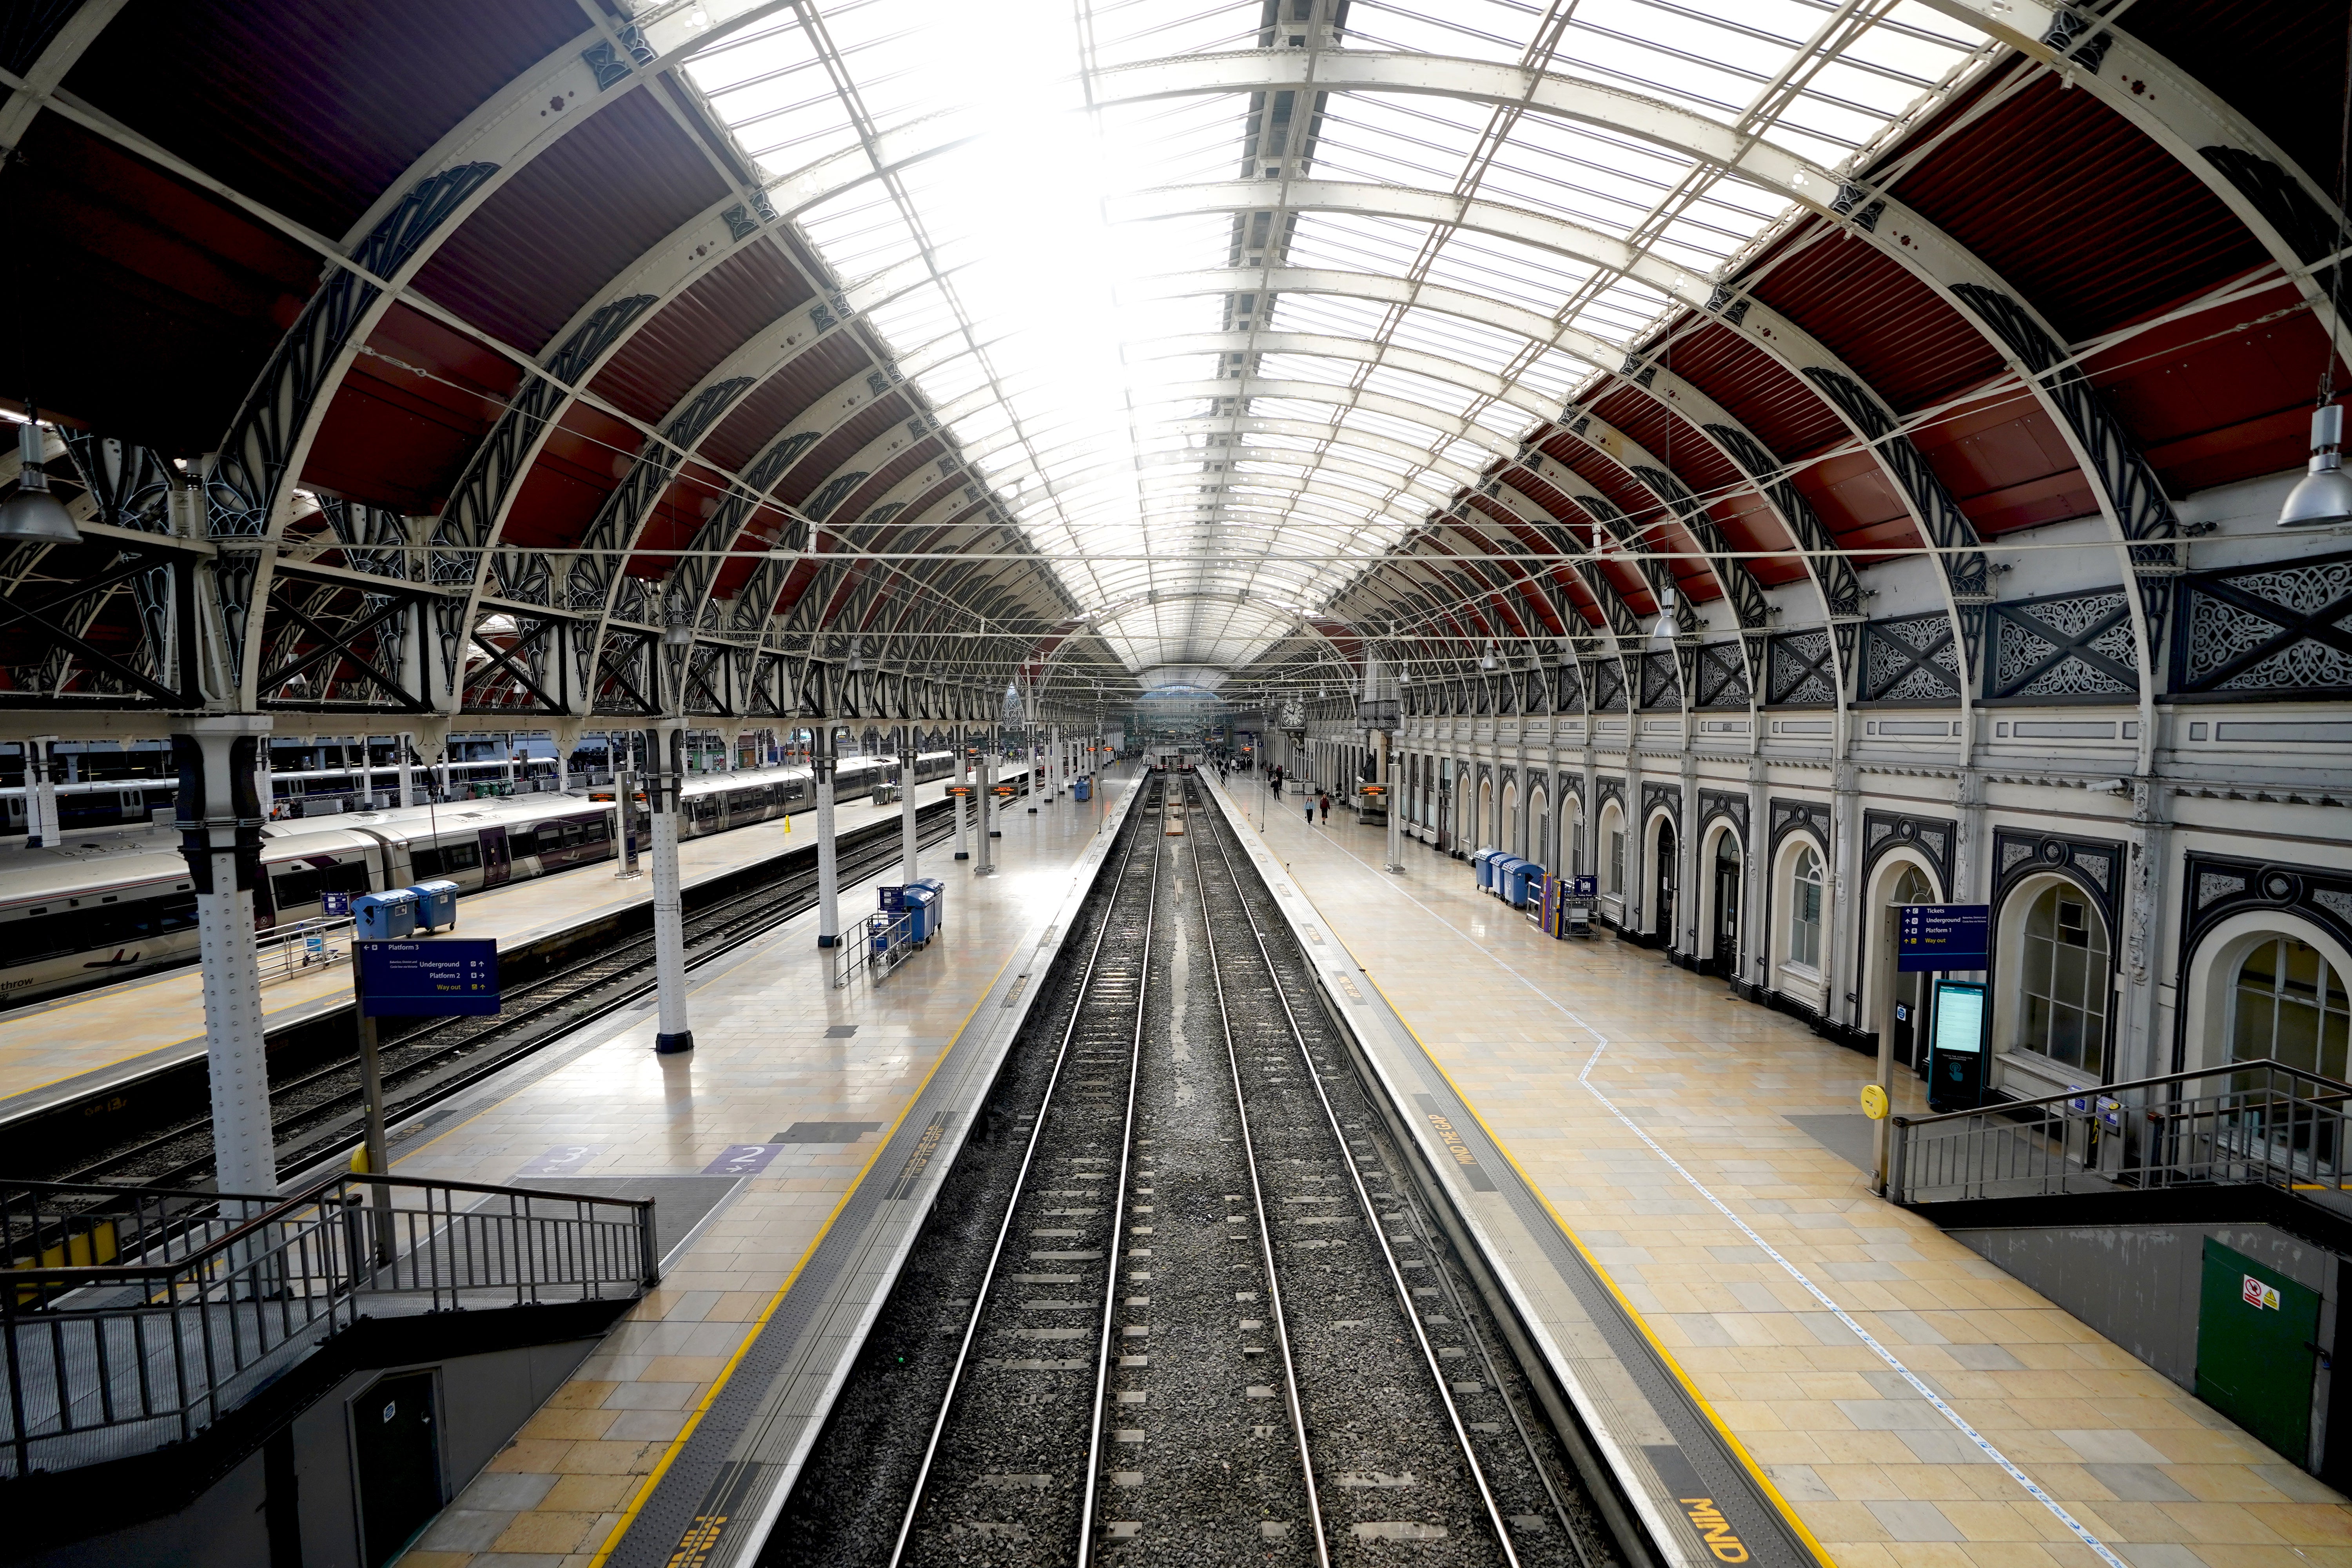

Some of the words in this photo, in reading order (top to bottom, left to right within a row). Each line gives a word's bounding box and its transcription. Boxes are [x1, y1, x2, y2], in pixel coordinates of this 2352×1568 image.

[626, 773, 630, 786] 4
[1428, 1114, 1452, 1130] GAP
[922, 1125, 944, 1141] GAP
[1439, 1131, 1462, 1145] THE
[550, 1147, 589, 1163] 3
[730, 1146, 765, 1162] 2
[913, 1143, 937, 1157] THE
[1449, 1146, 1477, 1165] MIND
[900, 1159, 927, 1178] MIND
[1679, 1498, 1749, 1563] MIND
[667, 1516, 728, 1568] MIN
